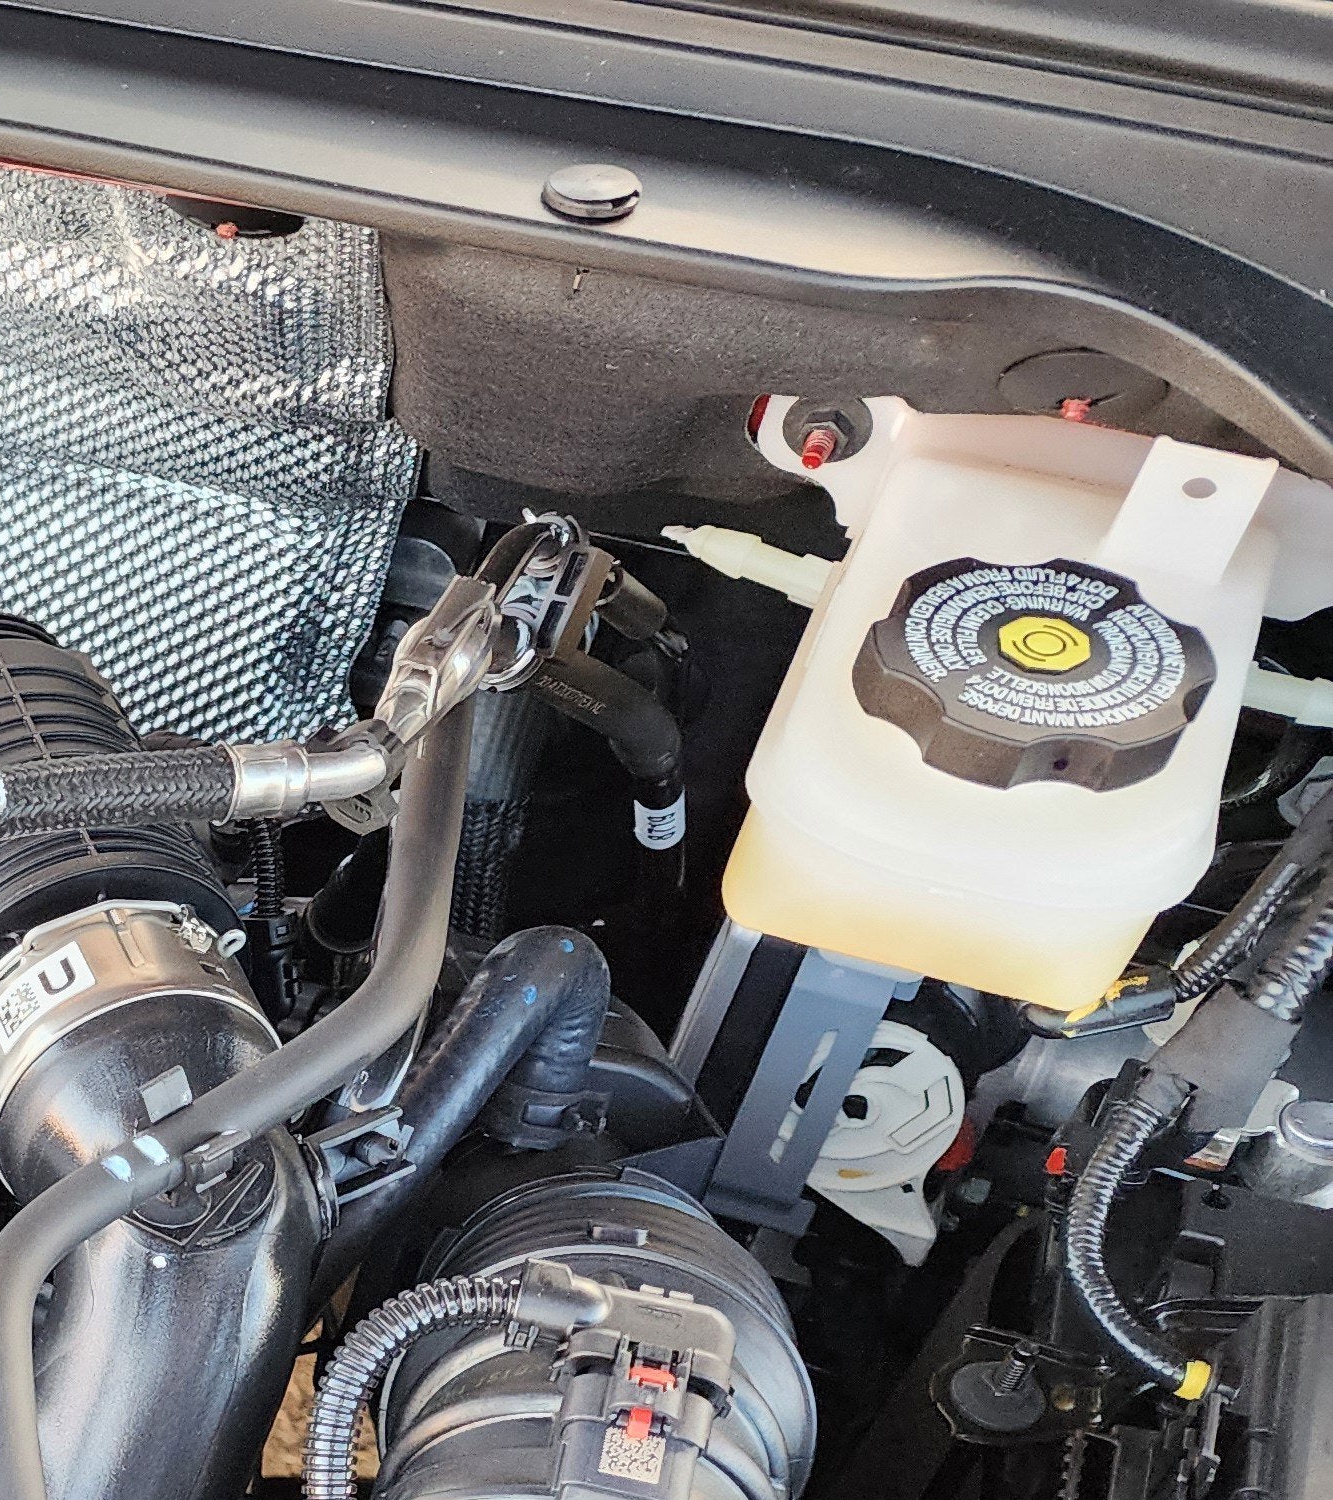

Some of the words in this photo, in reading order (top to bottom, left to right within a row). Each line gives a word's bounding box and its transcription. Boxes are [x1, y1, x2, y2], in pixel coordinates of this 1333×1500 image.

[956, 567, 1012, 586] FROM
[1011, 567, 1067, 583] FLUID
[993, 581, 1067, 597] BEFORE
[1064, 588, 1109, 610] CAP
[1078, 577, 1122, 599] DOT
[904, 580, 958, 619] SEALED
[927, 584, 1001, 625] REMOVING
[998, 595, 1097, 621] WARNING:
[957, 598, 1006, 630] CLEAN
[929, 620, 953, 642] USE
[955, 627, 987, 665] FILLER
[931, 643, 971, 675] ONLY
[975, 679, 1009, 700] DOT
[1019, 708, 1075, 728] AVANT
[37, 956, 76, 996] U
